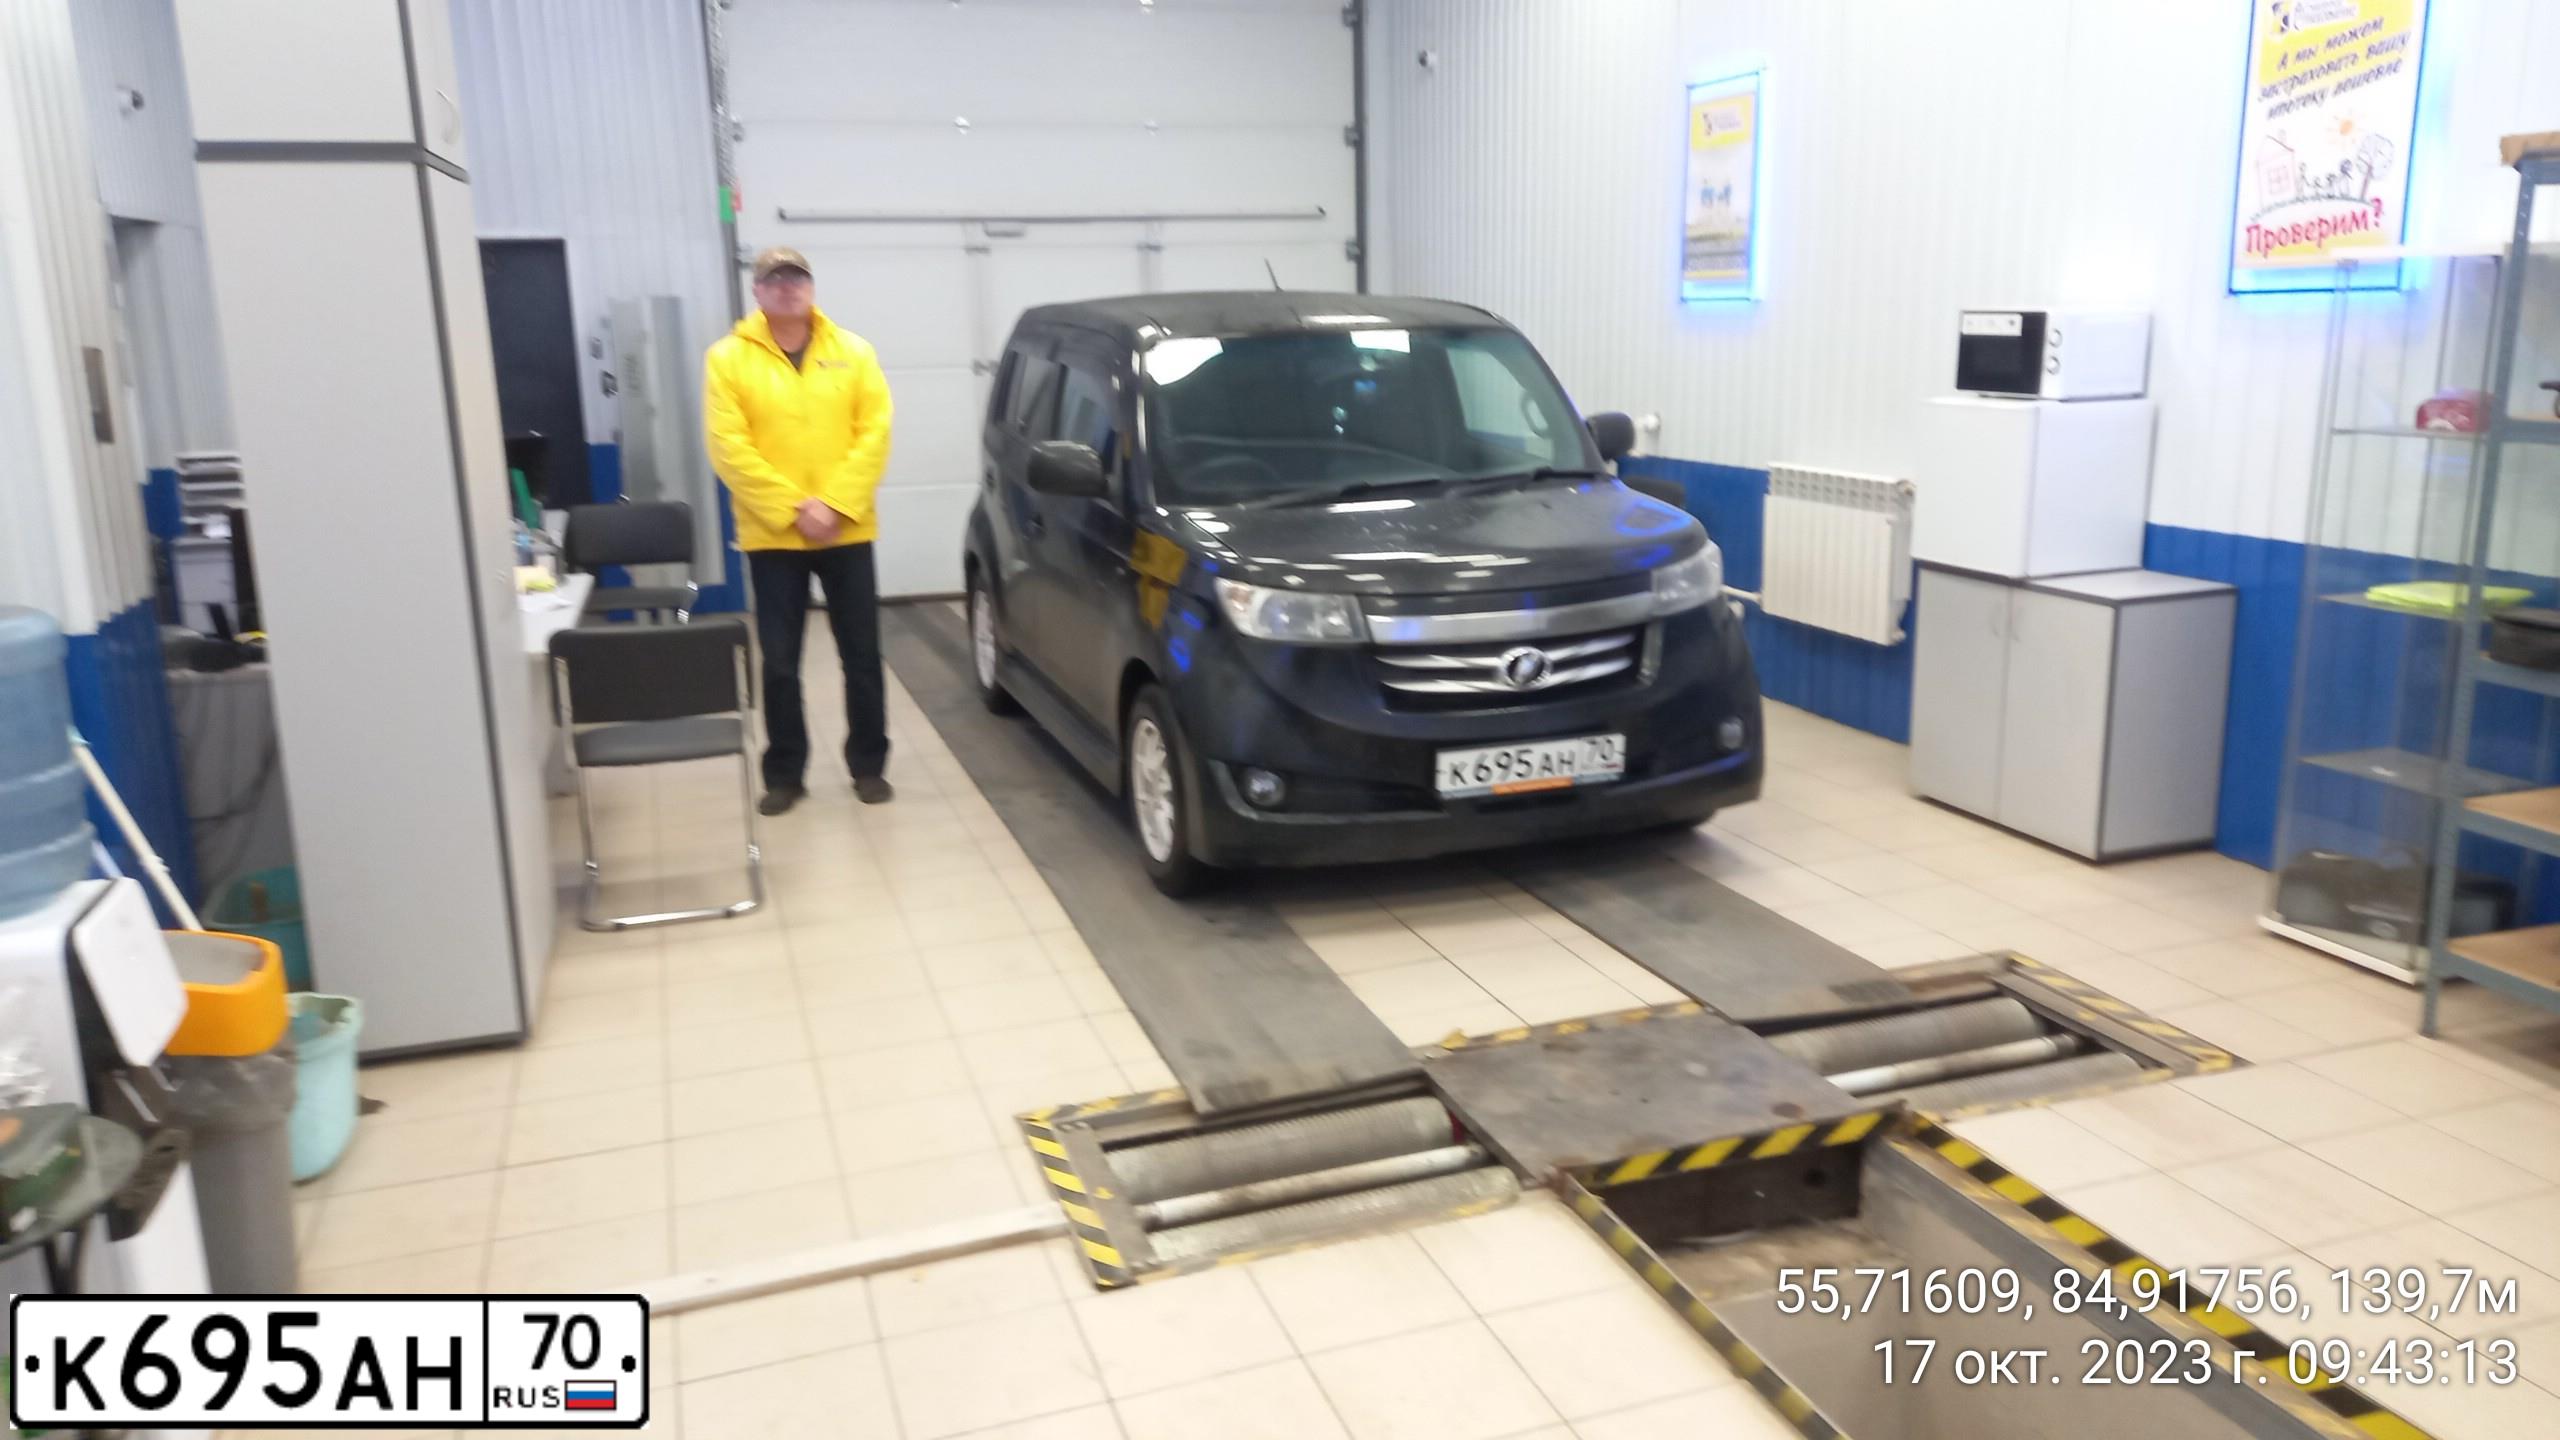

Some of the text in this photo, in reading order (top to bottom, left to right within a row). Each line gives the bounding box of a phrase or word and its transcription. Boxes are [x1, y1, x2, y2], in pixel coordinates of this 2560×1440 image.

[2325, 16, 2385, 51] можем
[2258, 31, 2411, 102] застраховать вашу
[2267, 57, 2403, 120] ипотеку дешевле
[2245, 197, 2384, 259] Проверим?
[1450, 736, 1616, 787] К695АН 70
